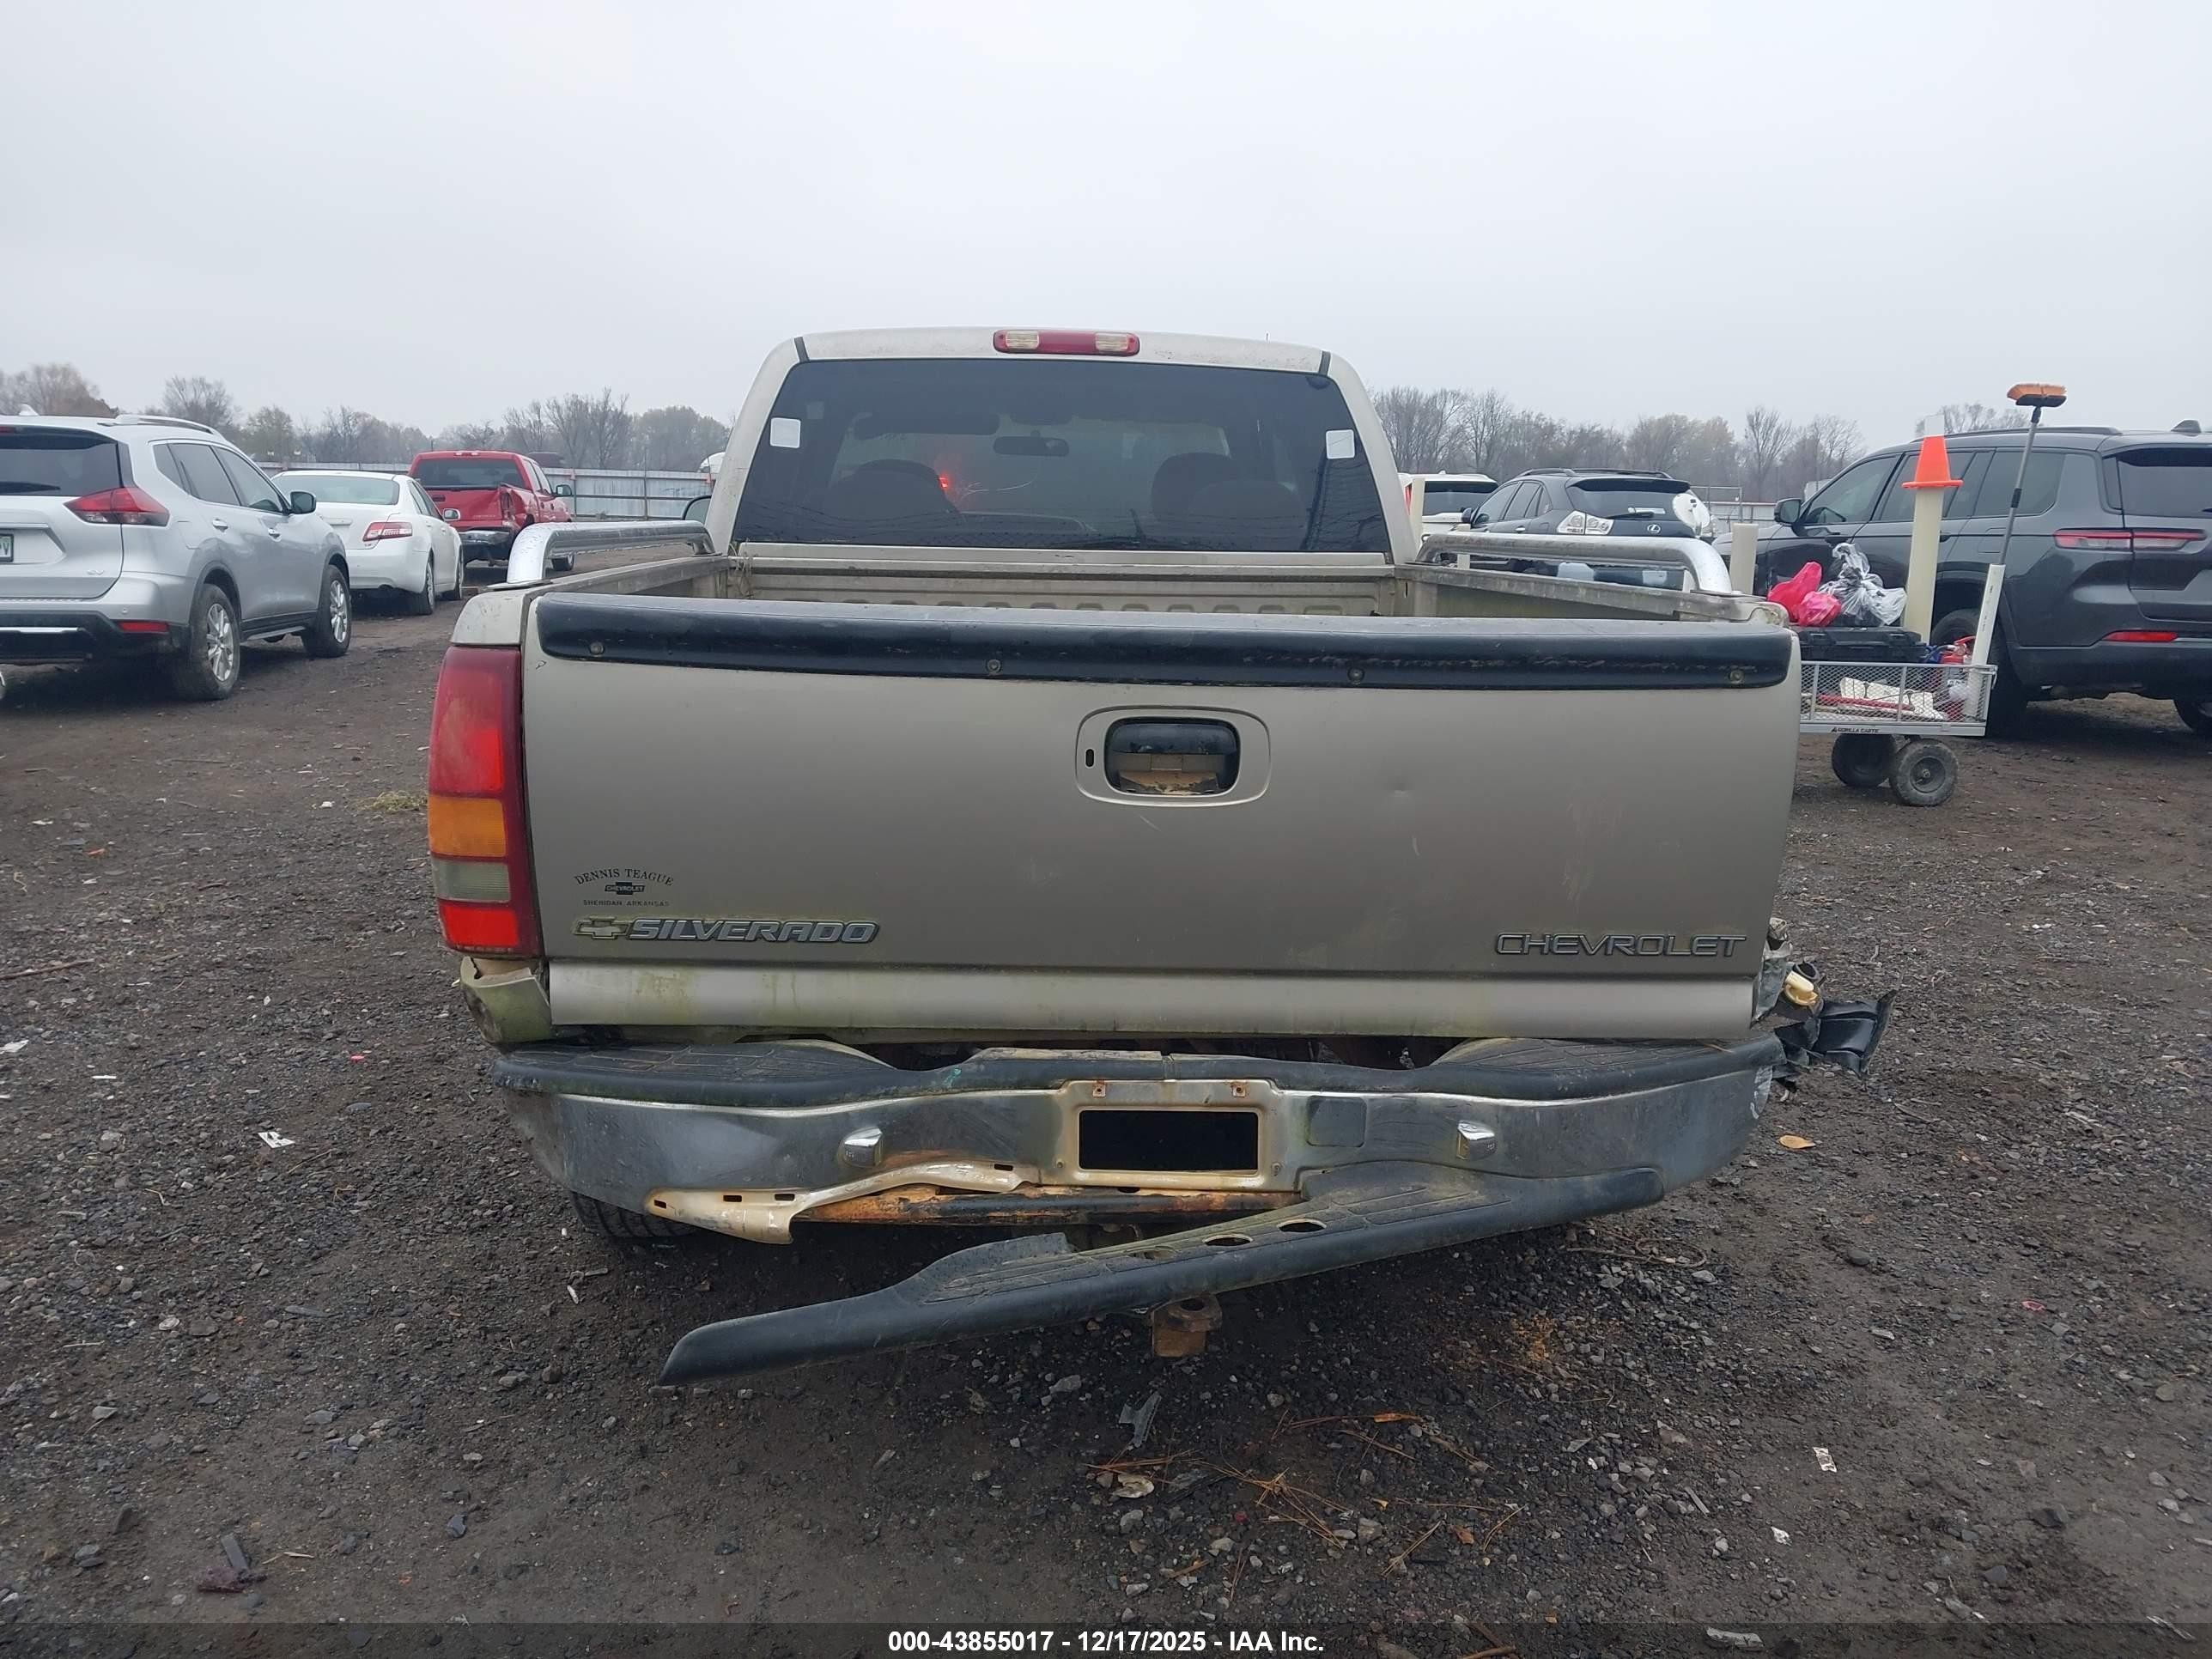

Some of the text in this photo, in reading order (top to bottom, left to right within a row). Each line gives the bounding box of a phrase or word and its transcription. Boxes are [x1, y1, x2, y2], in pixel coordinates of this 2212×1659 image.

[574, 868, 674, 886] DENNIS TEAGUE
[628, 919, 879, 944] SILVERADO
[1496, 933, 1747, 957] CHEVROLET
